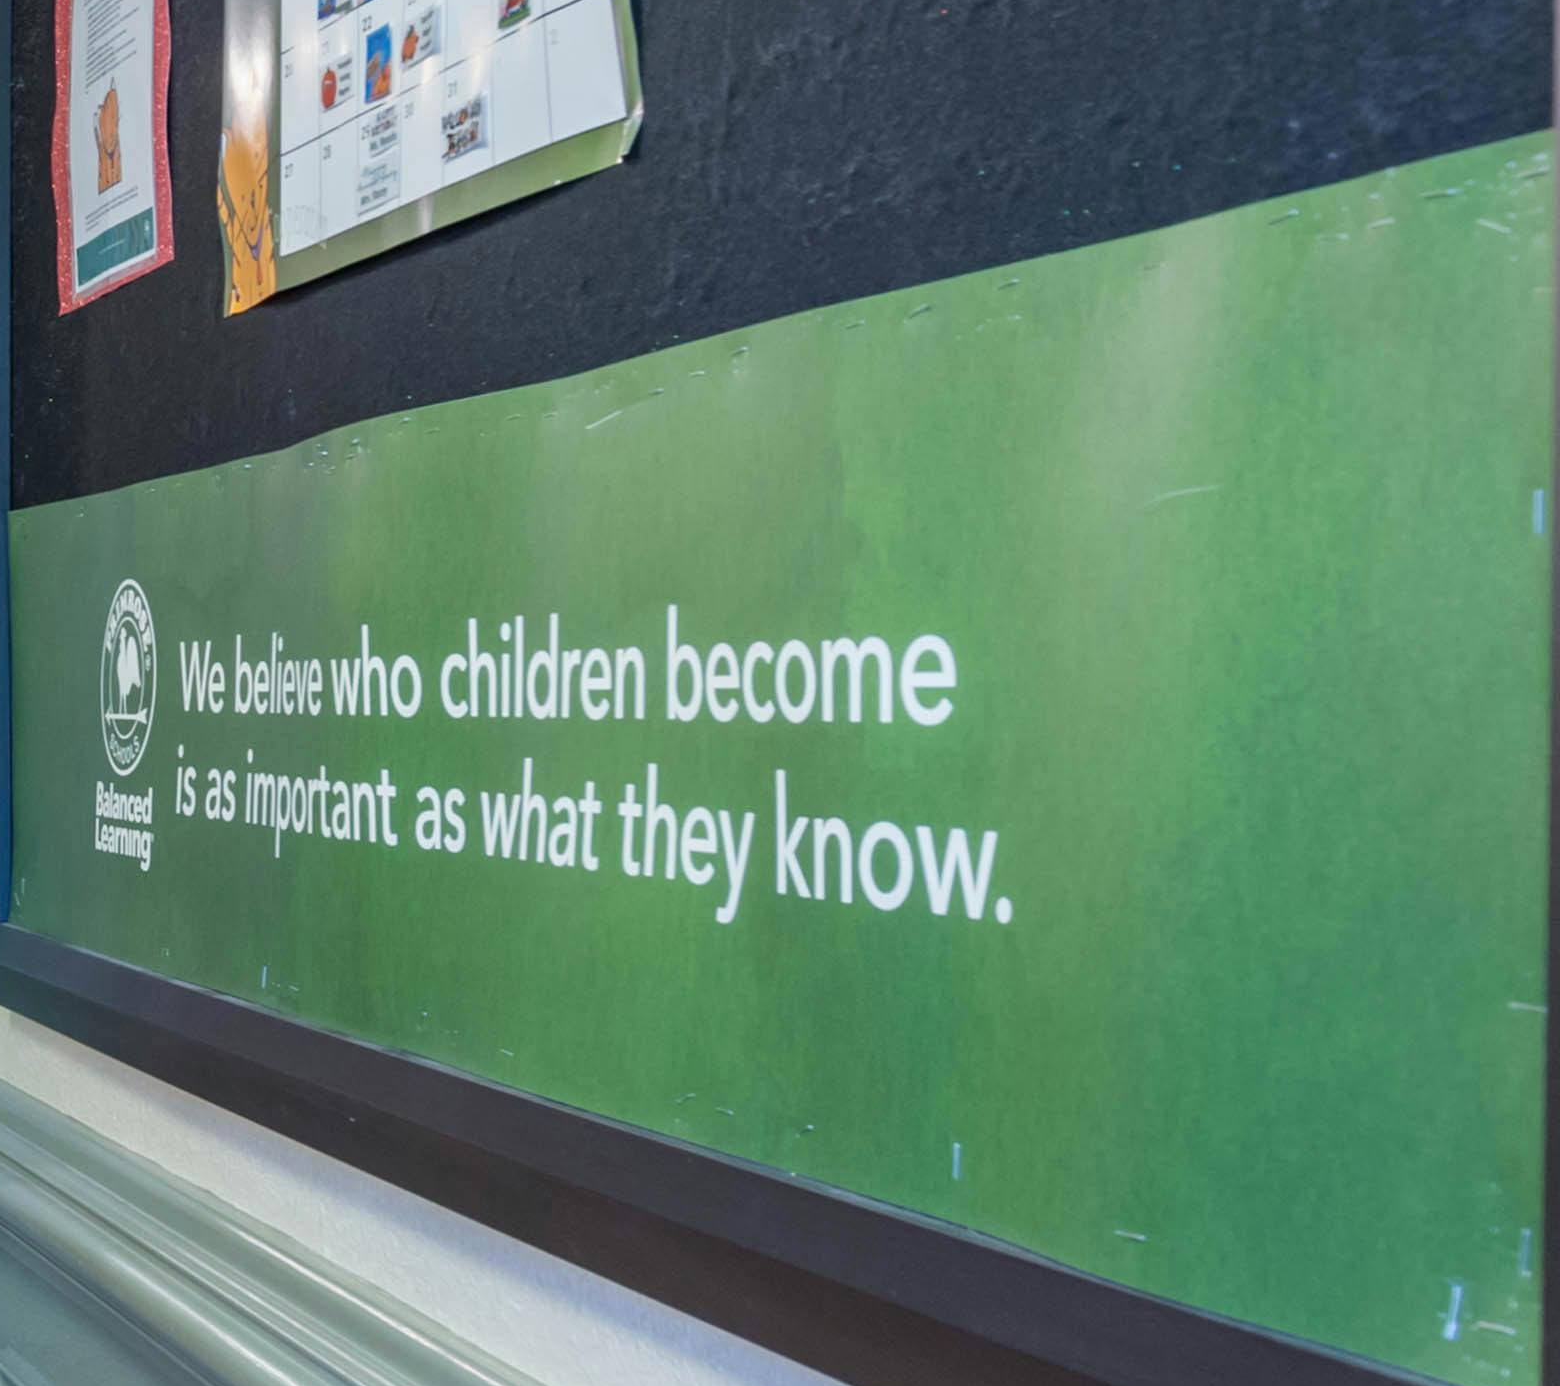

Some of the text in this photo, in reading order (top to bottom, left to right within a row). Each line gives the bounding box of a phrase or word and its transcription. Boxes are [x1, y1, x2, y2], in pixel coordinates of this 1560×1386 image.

[105, 589, 153, 653] PRIMROSE
[179, 604, 957, 725] We believe who children become
[96, 780, 153, 825] Balanced
[95, 817, 154, 872] Learning
[176, 745, 1014, 926] is as important as what they know.
